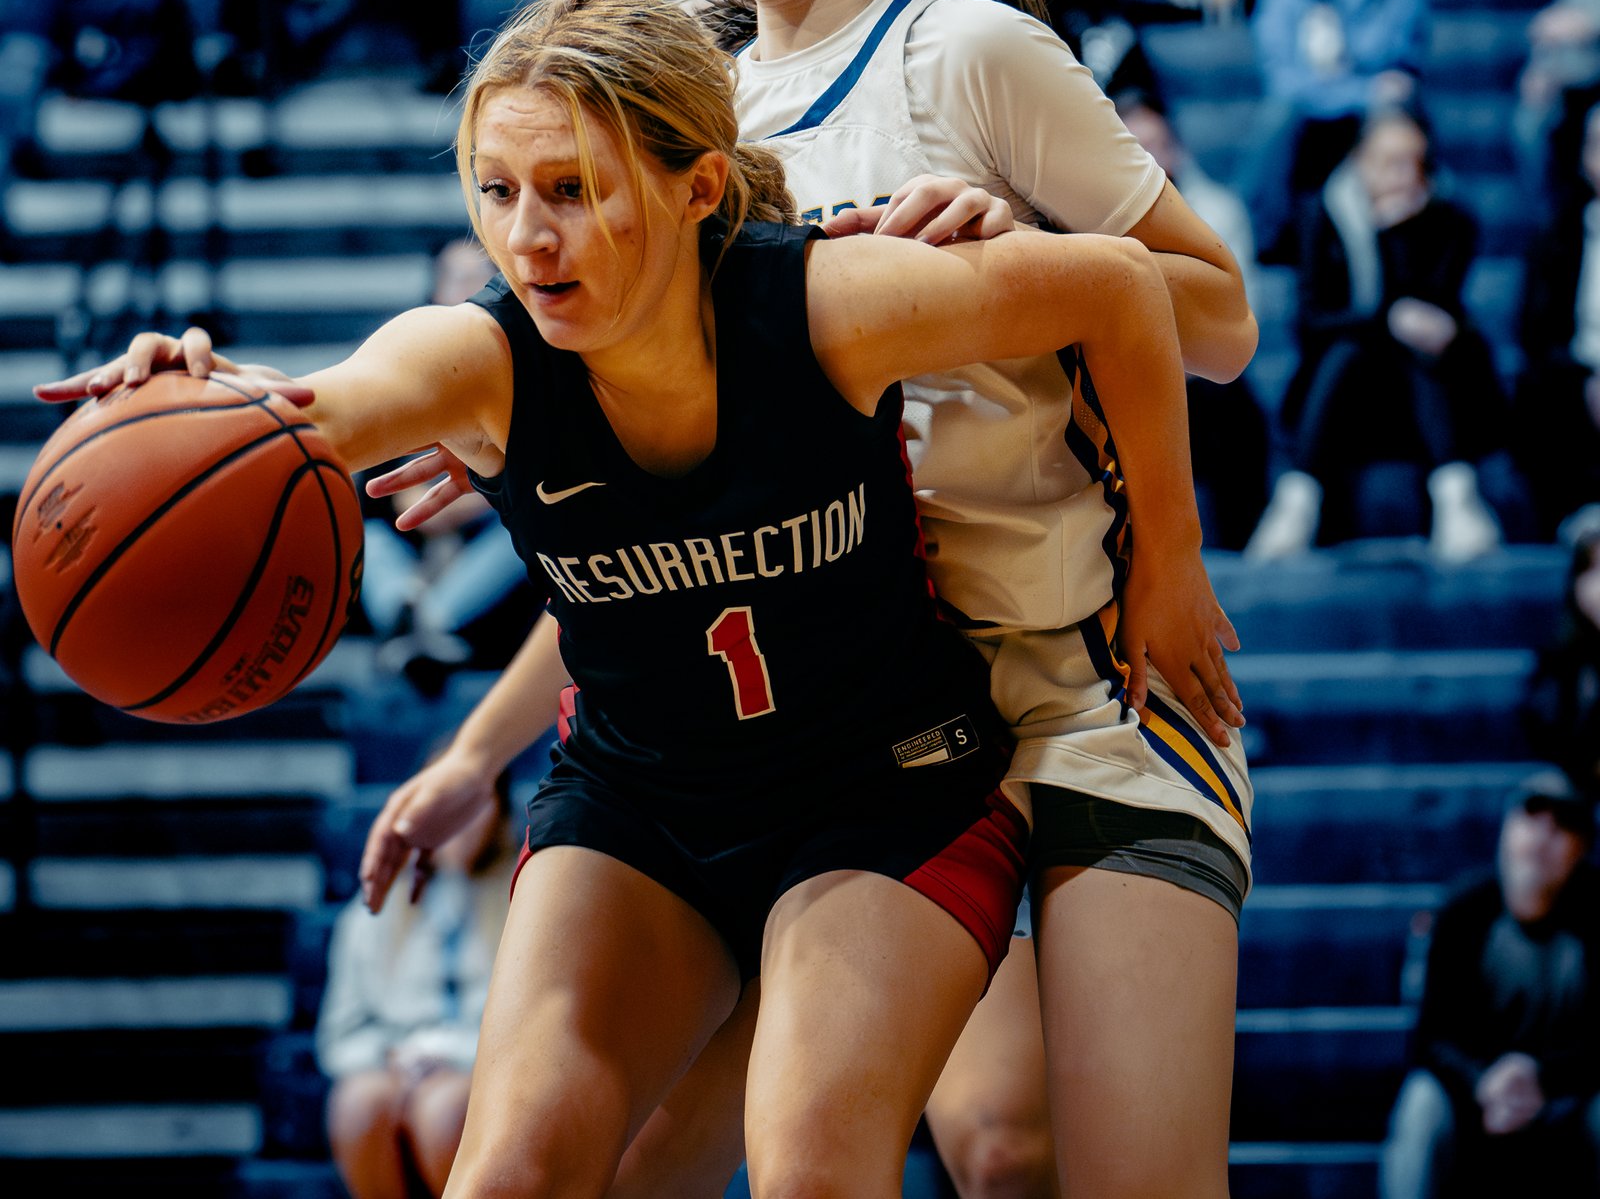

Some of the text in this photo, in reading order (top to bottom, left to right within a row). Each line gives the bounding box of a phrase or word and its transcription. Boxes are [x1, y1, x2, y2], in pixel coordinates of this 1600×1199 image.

[536, 483, 865, 603] RESURRECTION
[705, 606, 776, 720] 1
[896, 730, 941, 754] ENGINEERED
[955, 728, 967, 745] S
